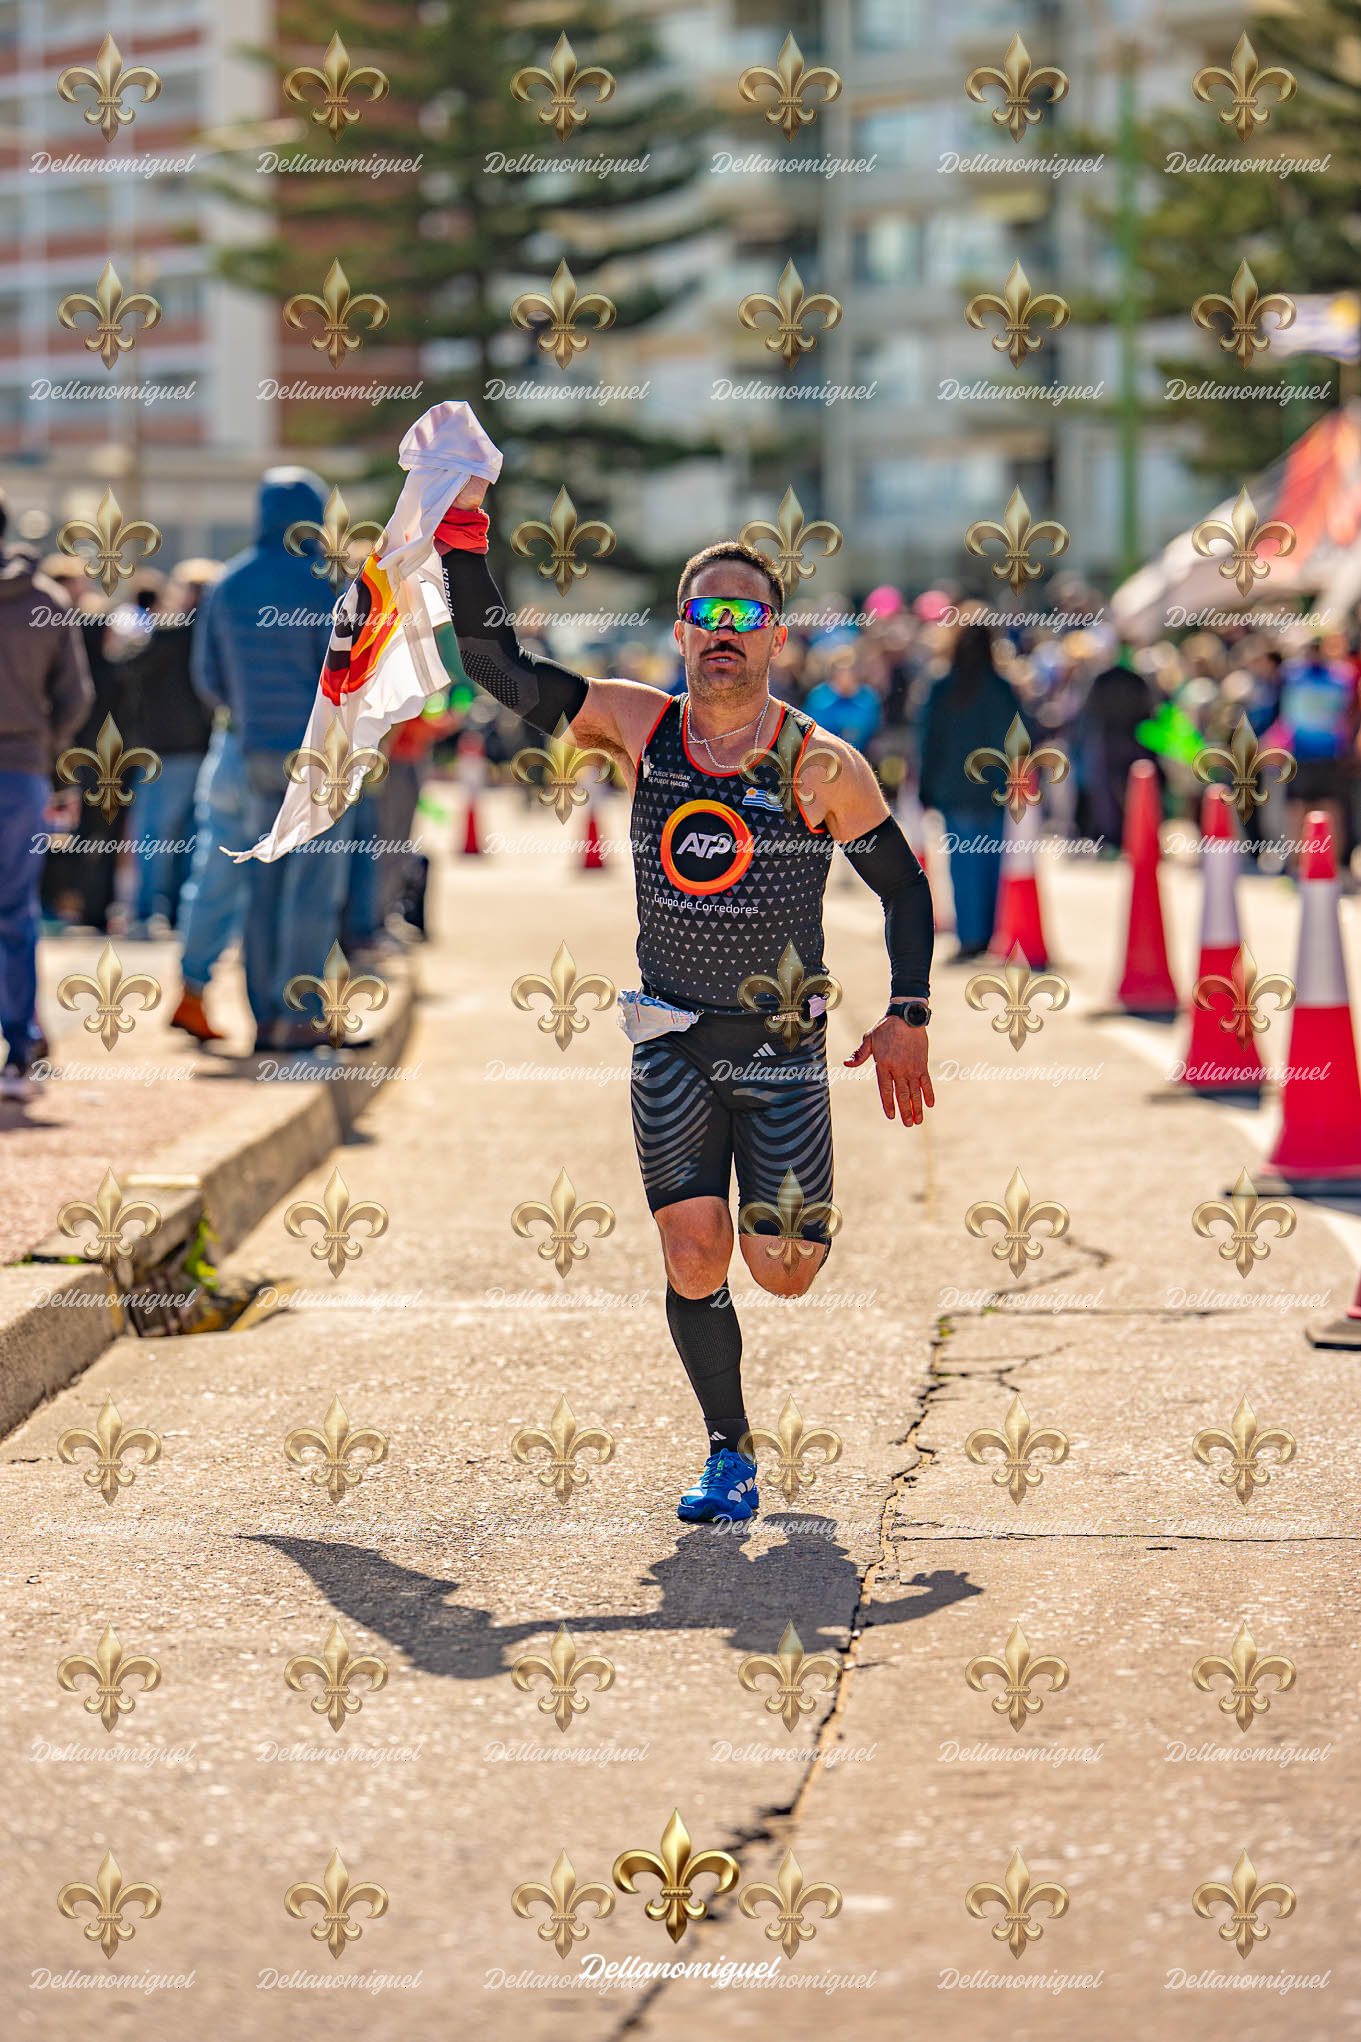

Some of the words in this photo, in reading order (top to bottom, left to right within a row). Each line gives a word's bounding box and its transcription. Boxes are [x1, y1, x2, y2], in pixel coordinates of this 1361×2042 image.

[676, 832, 731, 859] ATP
[654, 893, 679, 907] Grupo
[680, 899, 693, 910] de
[696, 900, 759, 914] Corredores
